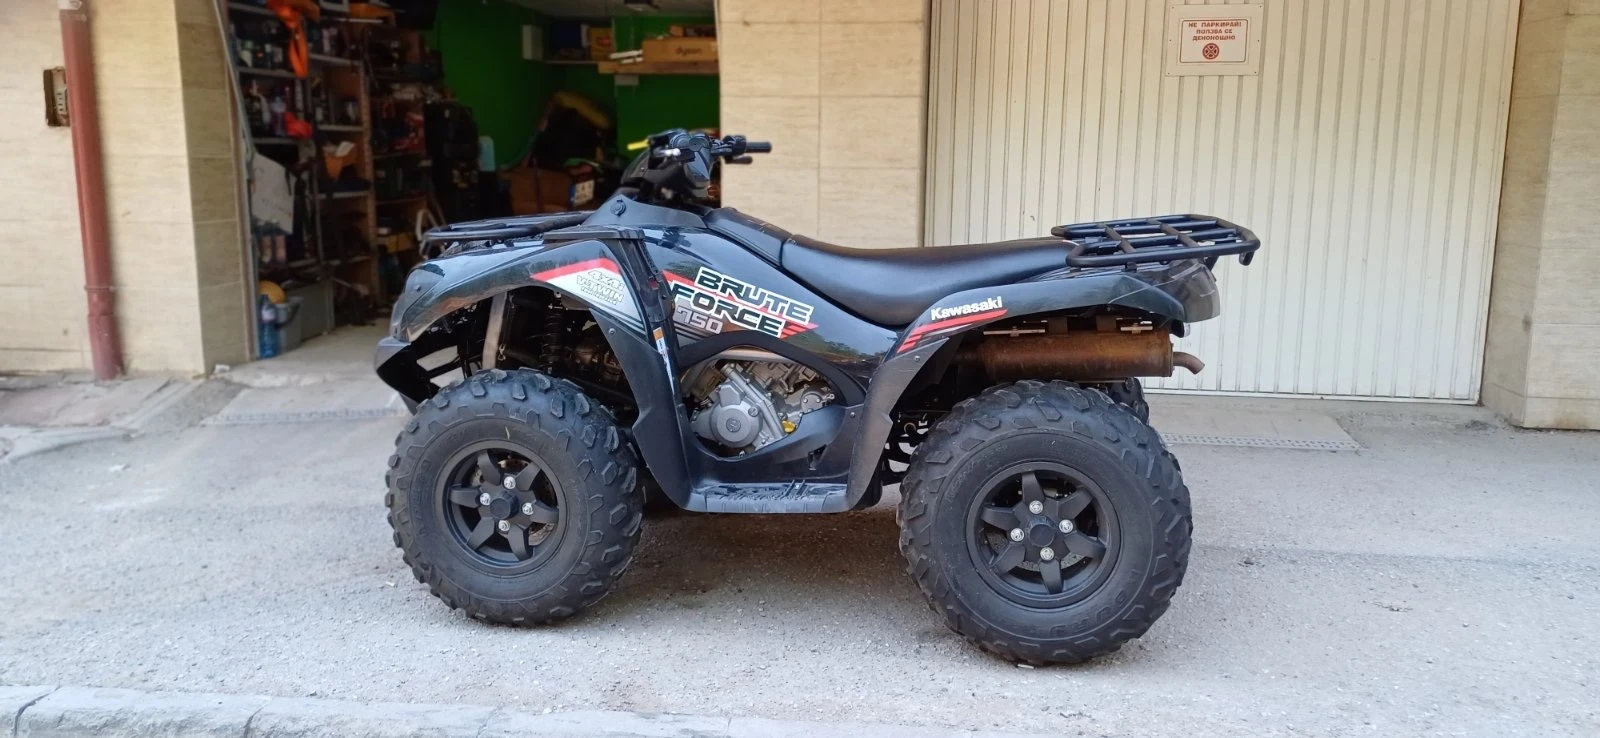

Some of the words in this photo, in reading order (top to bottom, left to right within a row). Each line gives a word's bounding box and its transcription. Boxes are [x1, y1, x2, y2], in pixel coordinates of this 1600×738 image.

[671, 280, 786, 338] FORCE
[694, 266, 814, 324] BRUTE
[930, 296, 1003, 320] Kawasaki
[675, 305, 724, 334] 750
